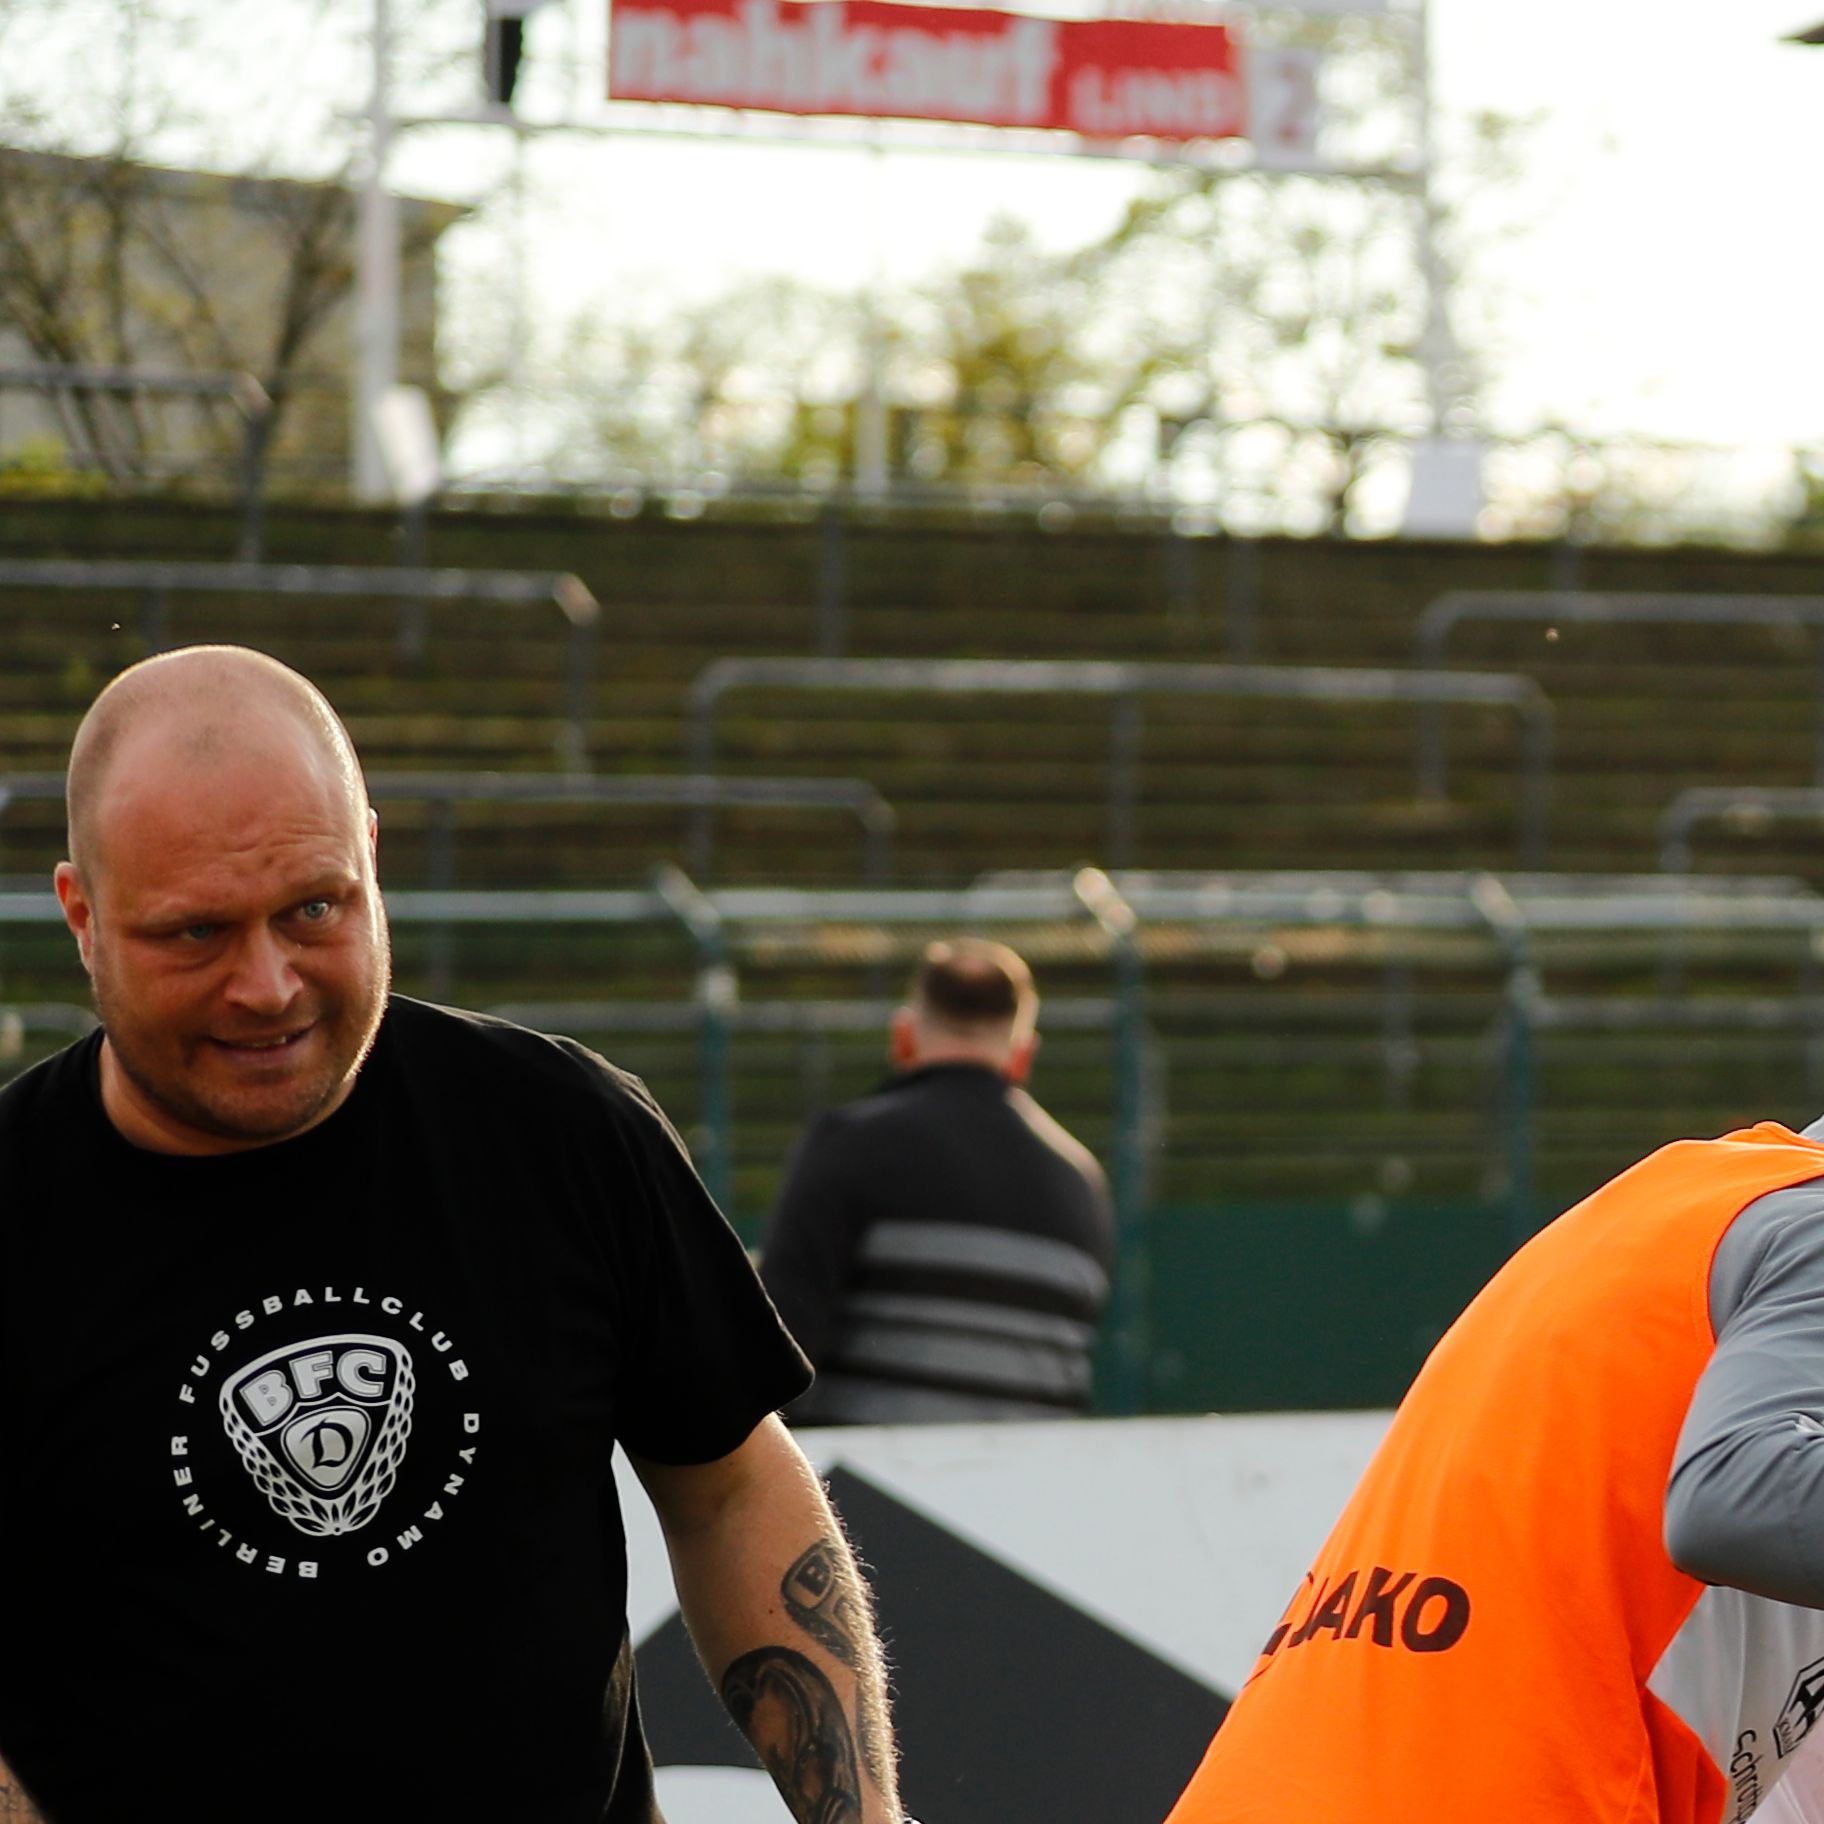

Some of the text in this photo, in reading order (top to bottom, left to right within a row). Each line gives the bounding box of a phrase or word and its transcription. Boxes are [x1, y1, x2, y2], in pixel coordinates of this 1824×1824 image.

[179, 1286, 469, 1404] FUSSBALLCLUB
[239, 1349, 388, 1427] BFC
[171, 1436, 320, 1579] BERLINER
[367, 1412, 480, 1568] DYNAMO
